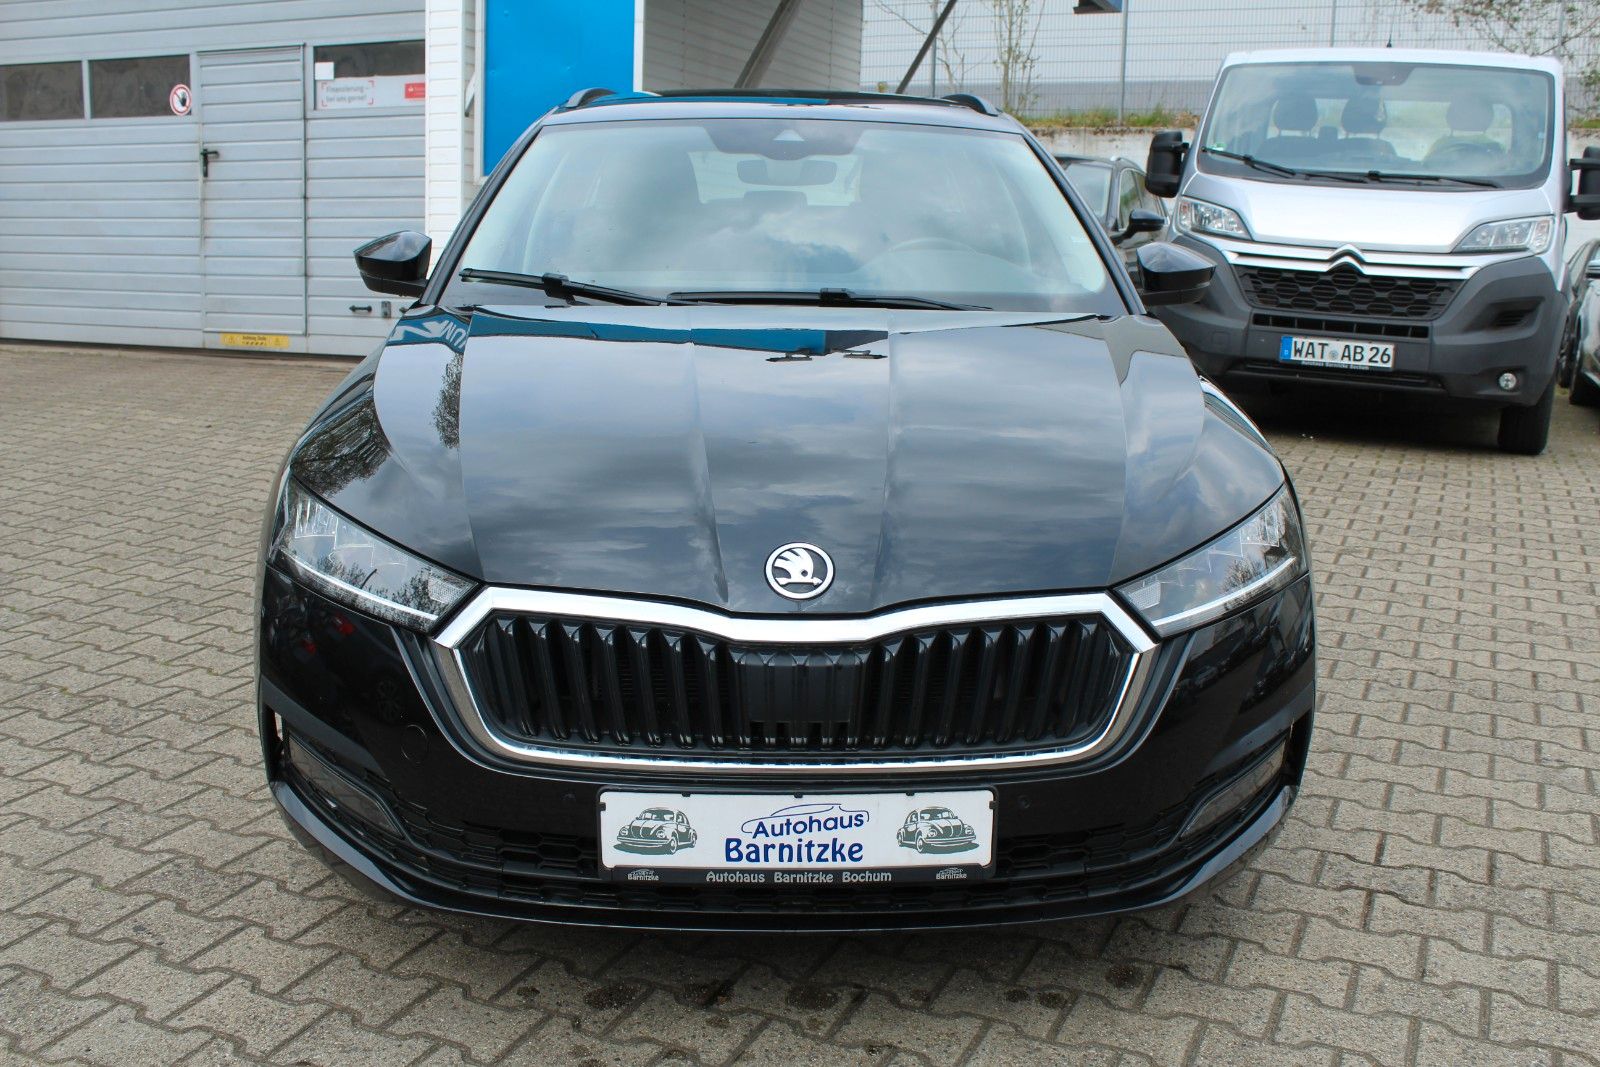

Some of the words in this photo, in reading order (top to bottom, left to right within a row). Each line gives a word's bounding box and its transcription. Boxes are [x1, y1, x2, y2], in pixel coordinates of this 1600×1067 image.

[1293, 340, 1329, 359] WAT
[1341, 344, 1364, 362] AB
[1368, 346, 1391, 364] 26
[752, 813, 864, 839] Autohaus
[725, 837, 864, 863] Barnitzke
[705, 870, 766, 883] Autohaus
[773, 871, 834, 884] Barnitzke
[842, 871, 892, 884] Bochum
